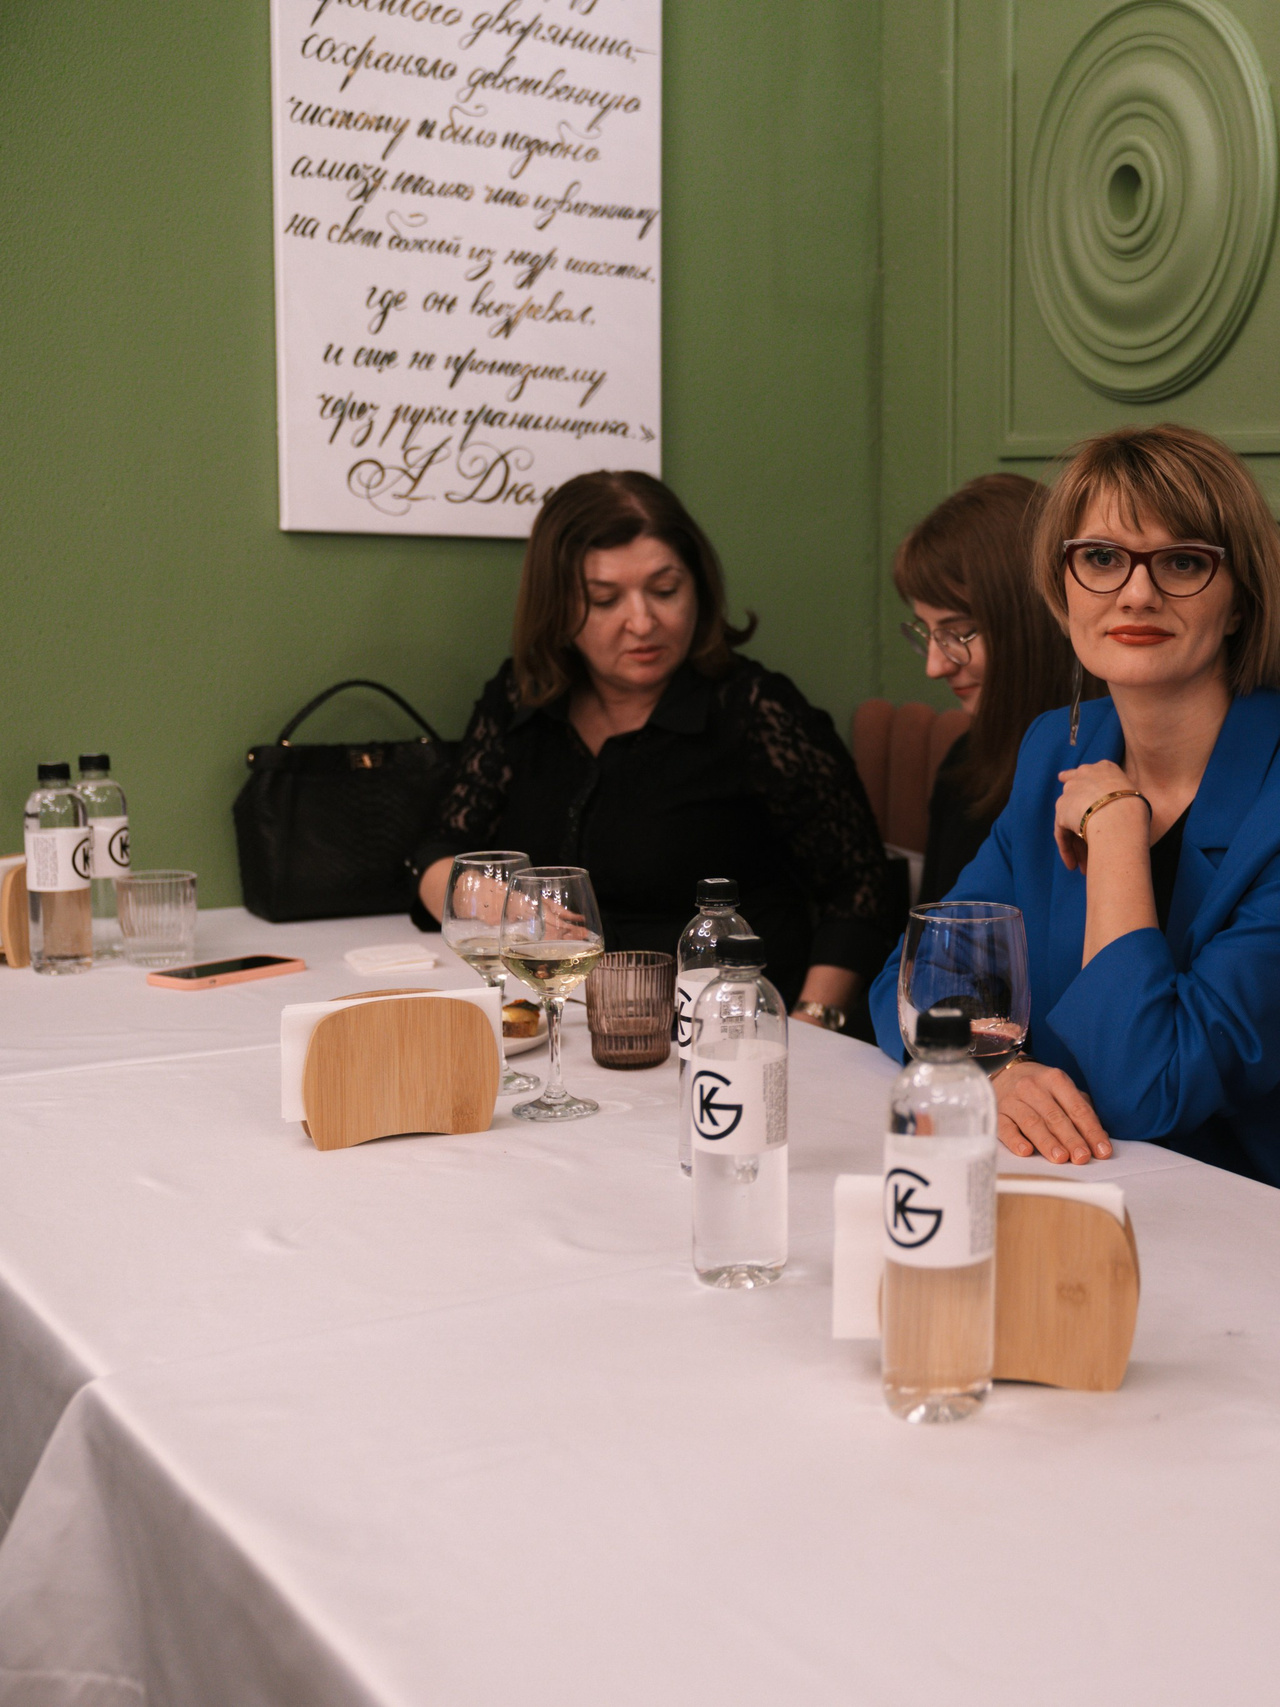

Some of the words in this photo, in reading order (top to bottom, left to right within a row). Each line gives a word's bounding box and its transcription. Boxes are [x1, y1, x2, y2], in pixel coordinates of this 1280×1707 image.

[301, 33, 457, 93] сохраняло
[456, 55, 642, 133] девственную
[287, 96, 410, 161] чистоту
[416, 118, 437, 140] и
[438, 104, 498, 149] было
[501, 120, 602, 180] подобно
[391, 171, 475, 202] только
[484, 184, 530, 208] что
[284, 213, 320, 239] на
[327, 204, 383, 249] свет
[386, 210, 463, 258] божий
[464, 246, 496, 282] из
[503, 246, 558, 290] недр
[365, 284, 408, 335] где
[422, 291, 459, 316] он
[323, 343, 344, 366] и
[408, 351, 436, 371] не
[444, 347, 607, 409] прошедшему
[317, 391, 380, 447] через
[378, 404, 459, 452] руки
